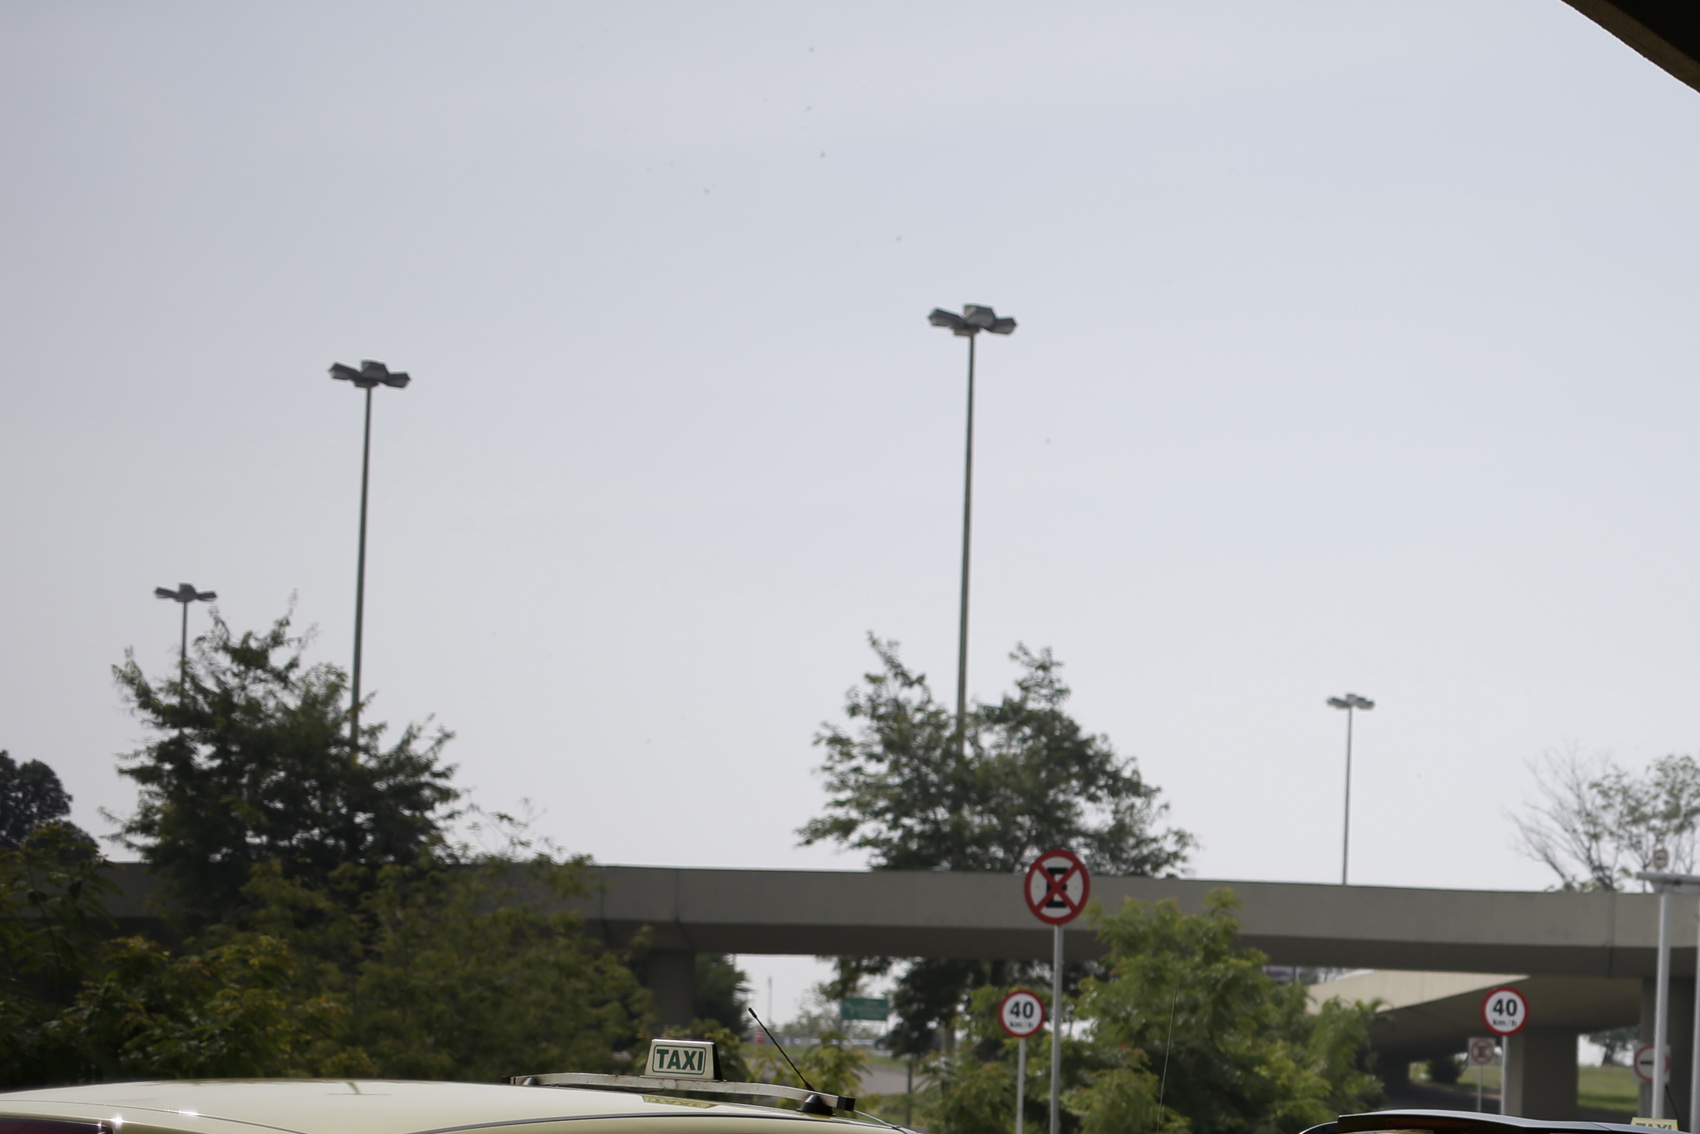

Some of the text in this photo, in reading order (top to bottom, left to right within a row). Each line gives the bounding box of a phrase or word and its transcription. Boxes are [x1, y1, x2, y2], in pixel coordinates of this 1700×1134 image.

[1010, 1001, 1034, 1019] 40
[1493, 998, 1517, 1017] 40
[656, 1049, 704, 1071] TAXI
